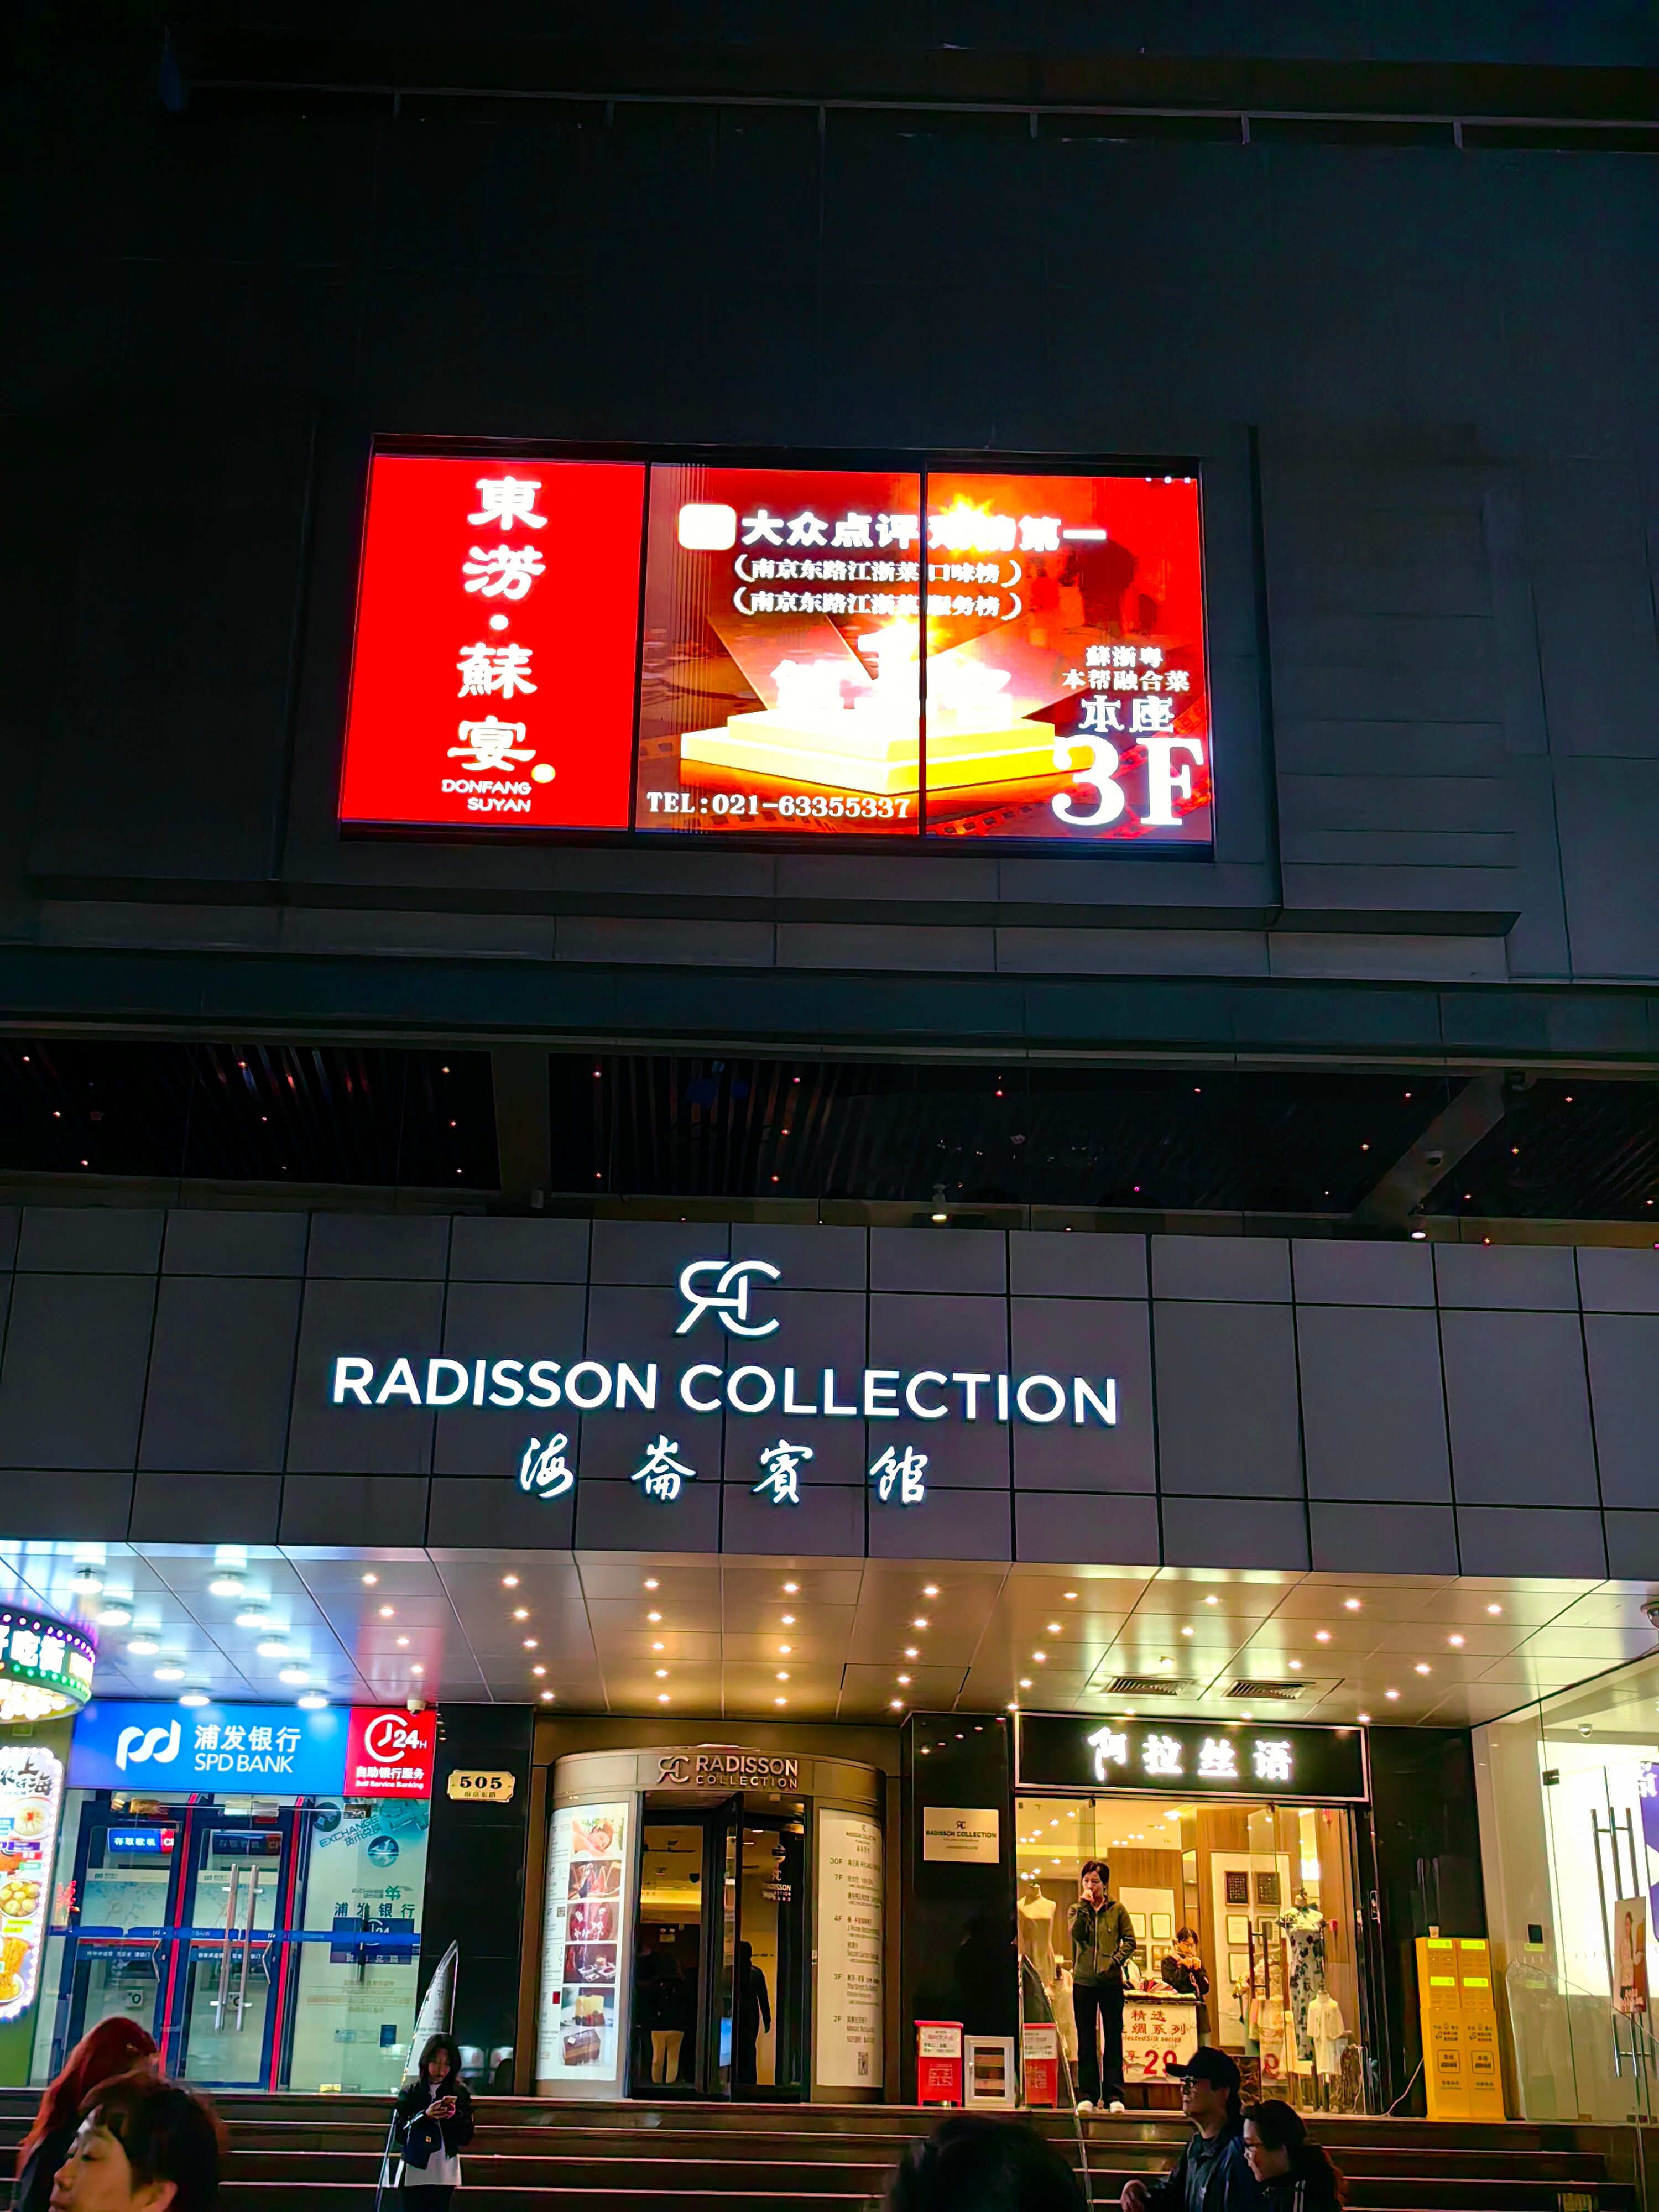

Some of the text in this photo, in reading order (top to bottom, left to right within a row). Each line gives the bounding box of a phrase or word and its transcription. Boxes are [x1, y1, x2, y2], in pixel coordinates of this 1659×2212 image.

[1062, 669, 1190, 692] 本帮融合菜
[441, 779, 533, 795] DONFANG
[1052, 735, 1204, 826] 3F
[467, 797, 531, 812] SUYAN
[333, 1356, 1117, 1426] RADISSON COLLECTION
[194, 1724, 301, 1752] 浦发银行
[194, 1752, 294, 1773] SPD BANK
[696, 1755, 798, 1777] RADISSON
[356, 1766, 425, 1780] 自助银行服务
[696, 1775, 797, 1788] COLLECTION
[396, 1781, 424, 1790] Banking
[460, 1776, 502, 1789] 505
[319, 1814, 380, 1848] EXCHANGE
[1131, 2009, 1167, 2022] 精选
